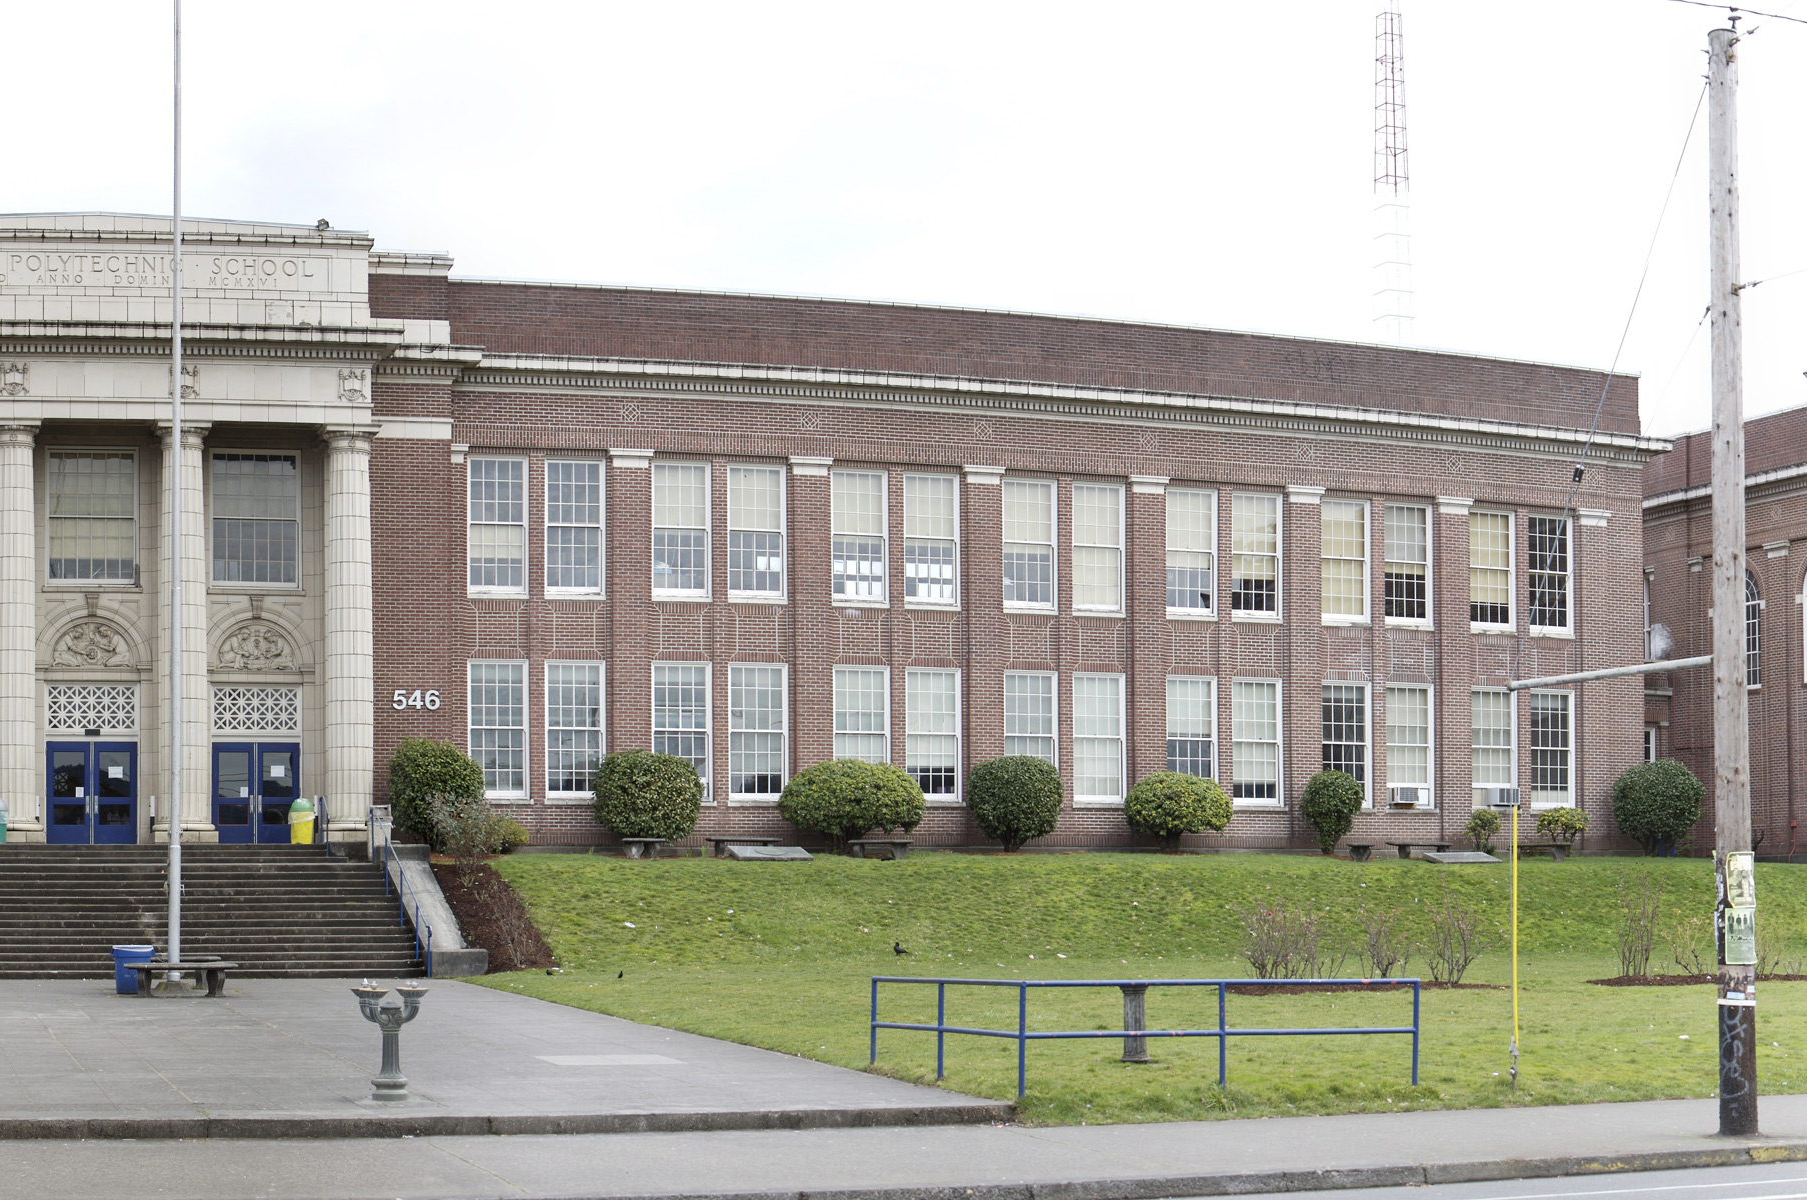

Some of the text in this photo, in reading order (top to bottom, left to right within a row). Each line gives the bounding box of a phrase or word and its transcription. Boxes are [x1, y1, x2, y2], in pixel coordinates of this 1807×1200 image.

[10, 254, 183, 274] POLYTECHNIC
[211, 257, 314, 278] SCHOOL
[36, 273, 84, 284] ANNO
[114, 274, 171, 285] DOMIN
[209, 276, 278, 287] MCMXVI
[392, 689, 441, 710] 546
